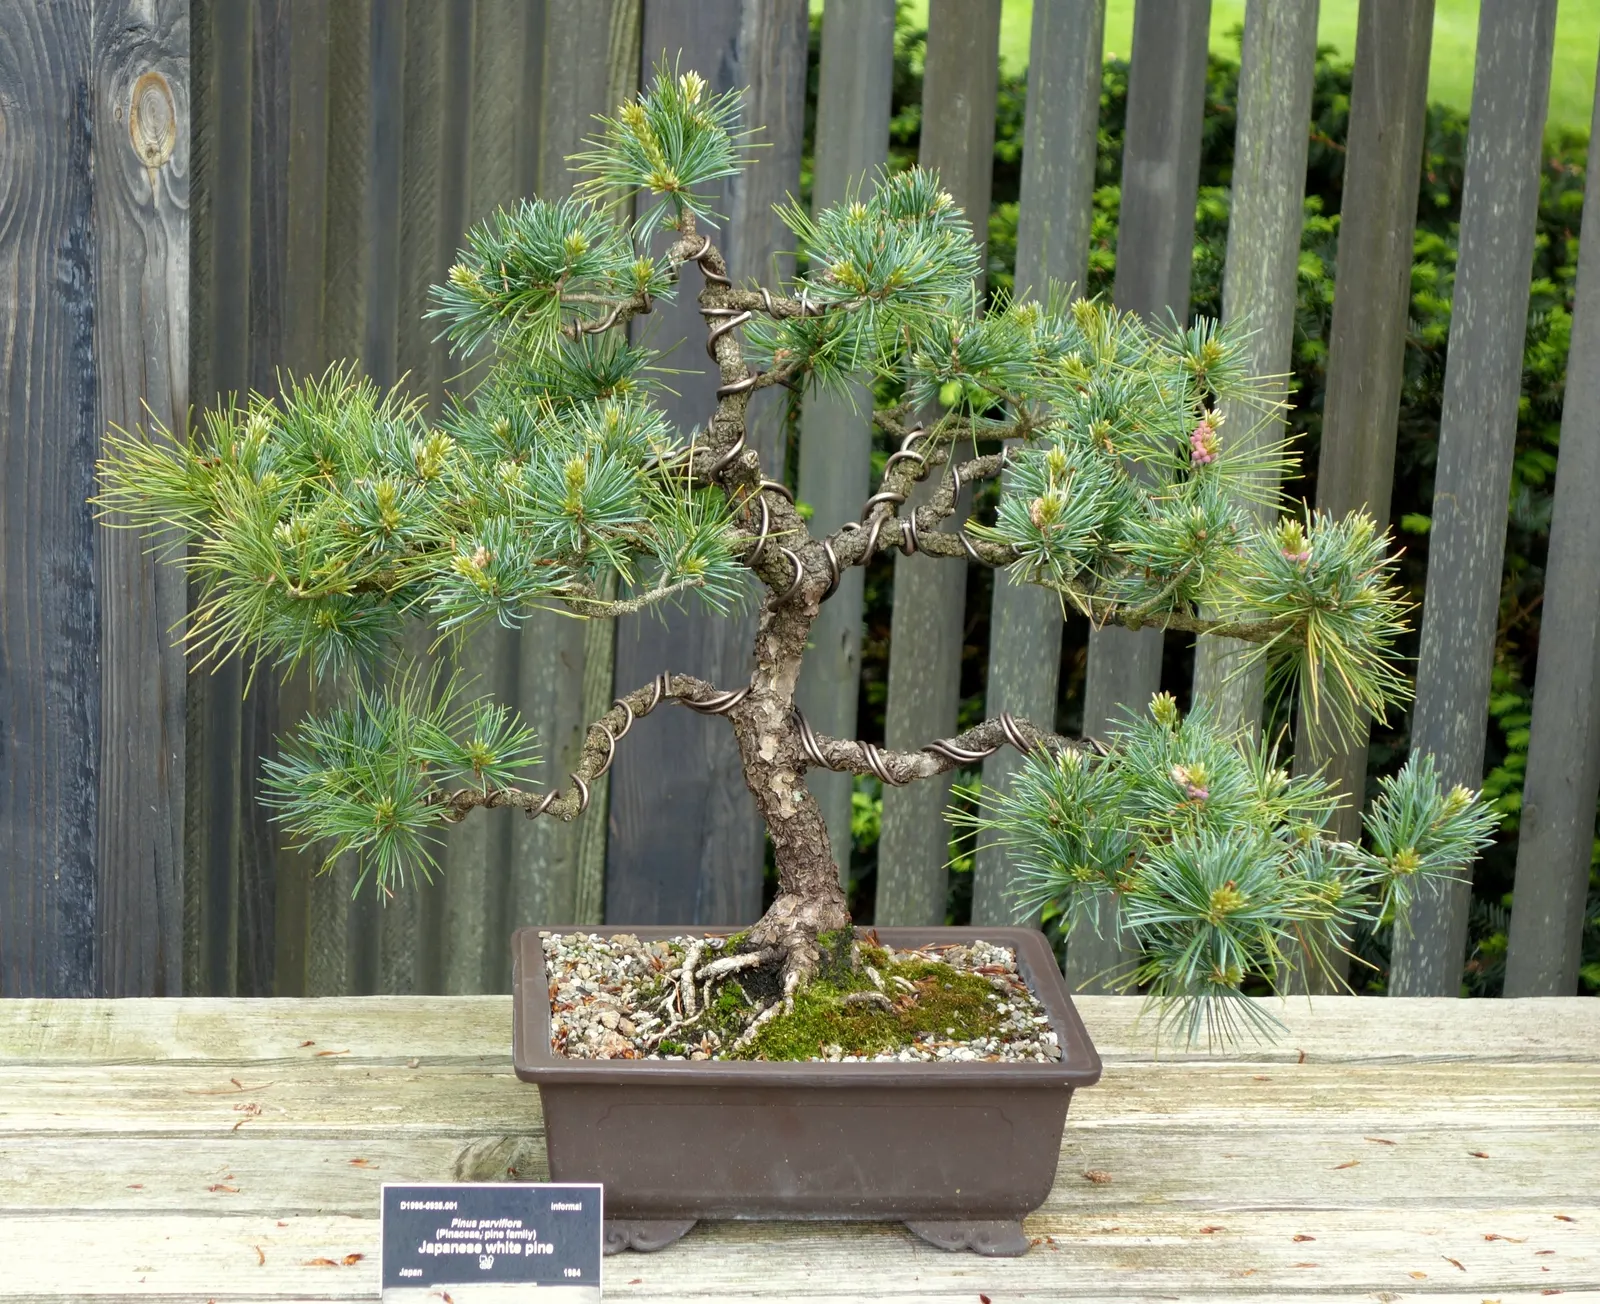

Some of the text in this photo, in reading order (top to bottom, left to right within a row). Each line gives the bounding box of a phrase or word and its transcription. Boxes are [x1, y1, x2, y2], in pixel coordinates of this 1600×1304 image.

[451, 1218, 522, 1230] Pinus parviflora
[484, 1229, 505, 1241] pine
[506, 1229, 537, 1241] family)
[418, 1240, 554, 1256] Japanese white pine
[399, 1267, 422, 1278] Japan
